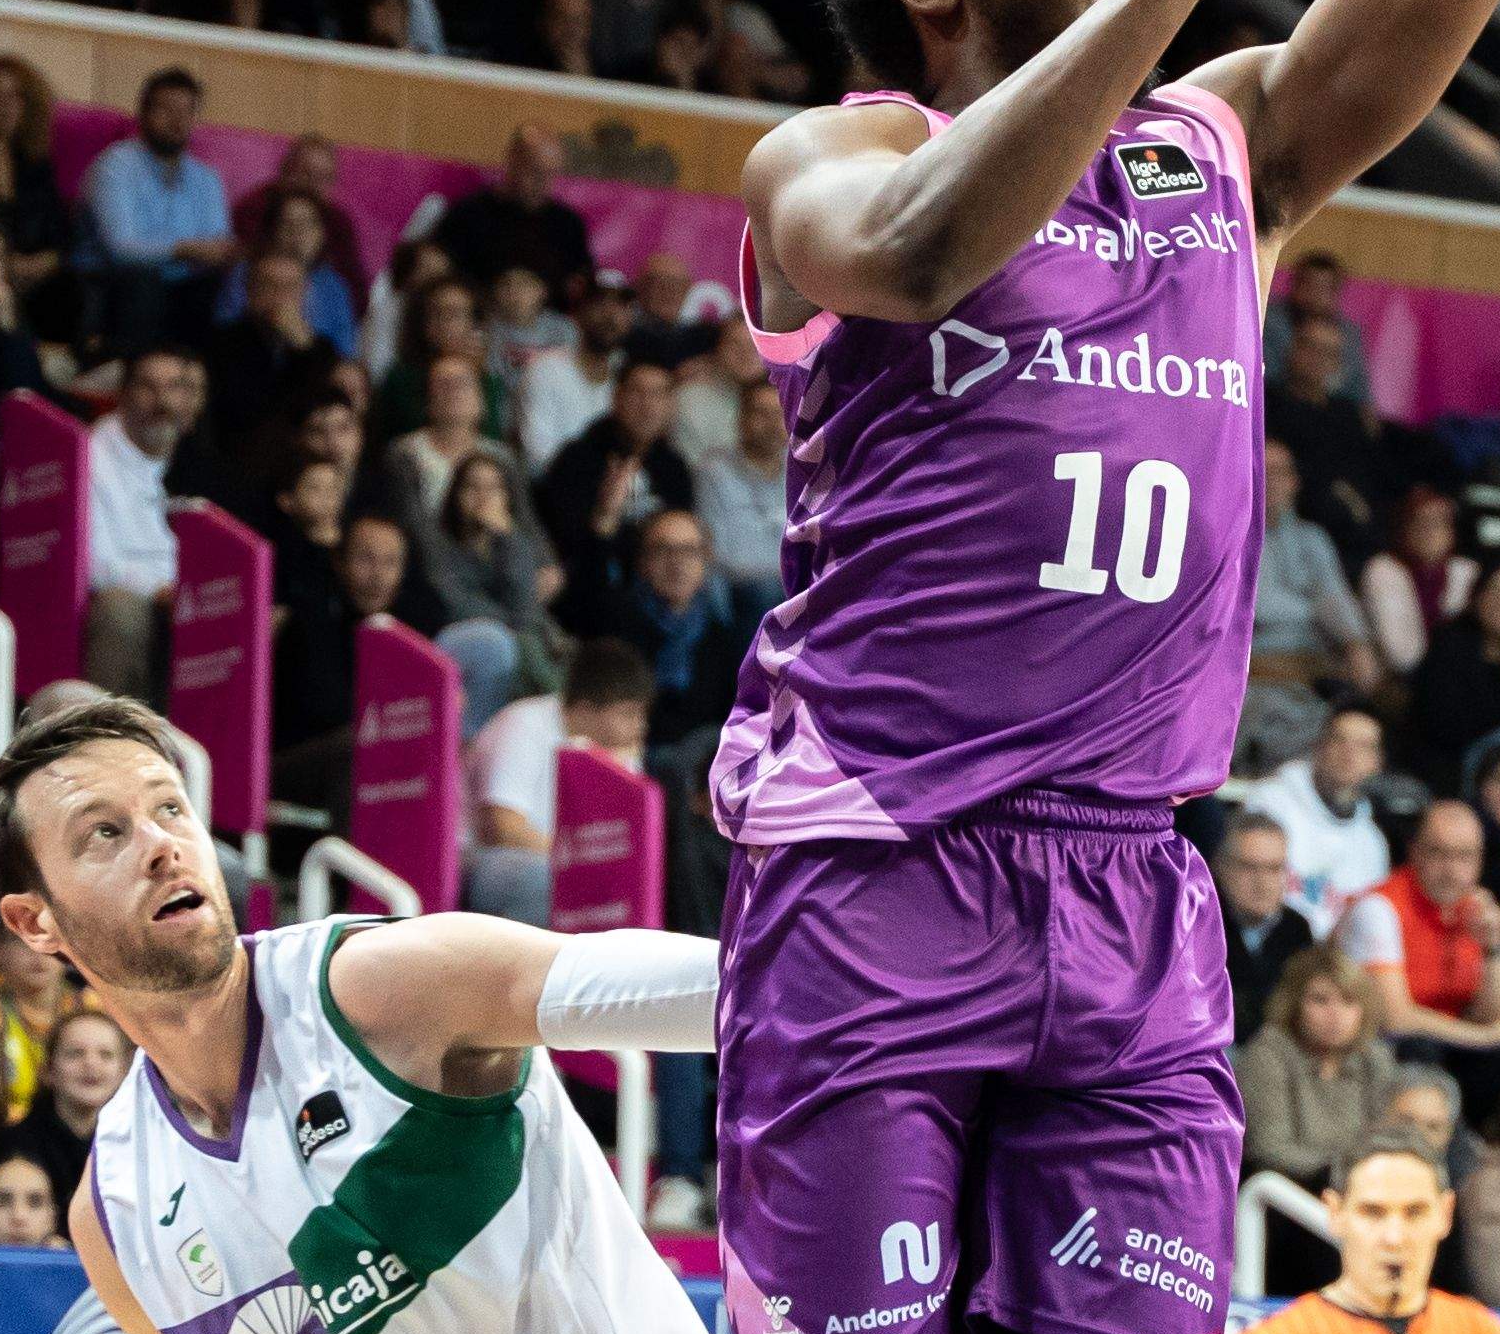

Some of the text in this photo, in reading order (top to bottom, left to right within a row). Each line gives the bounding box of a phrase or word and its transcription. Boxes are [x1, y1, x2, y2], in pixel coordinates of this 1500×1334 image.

[1128, 159, 1161, 177] liga
[1136, 172, 1200, 191] endesa
[1016, 326, 1249, 409] Andorra
[1038, 450, 1192, 605] 10
[1125, 1227, 1215, 1281] andorra
[1119, 1253, 1214, 1314] telecom
